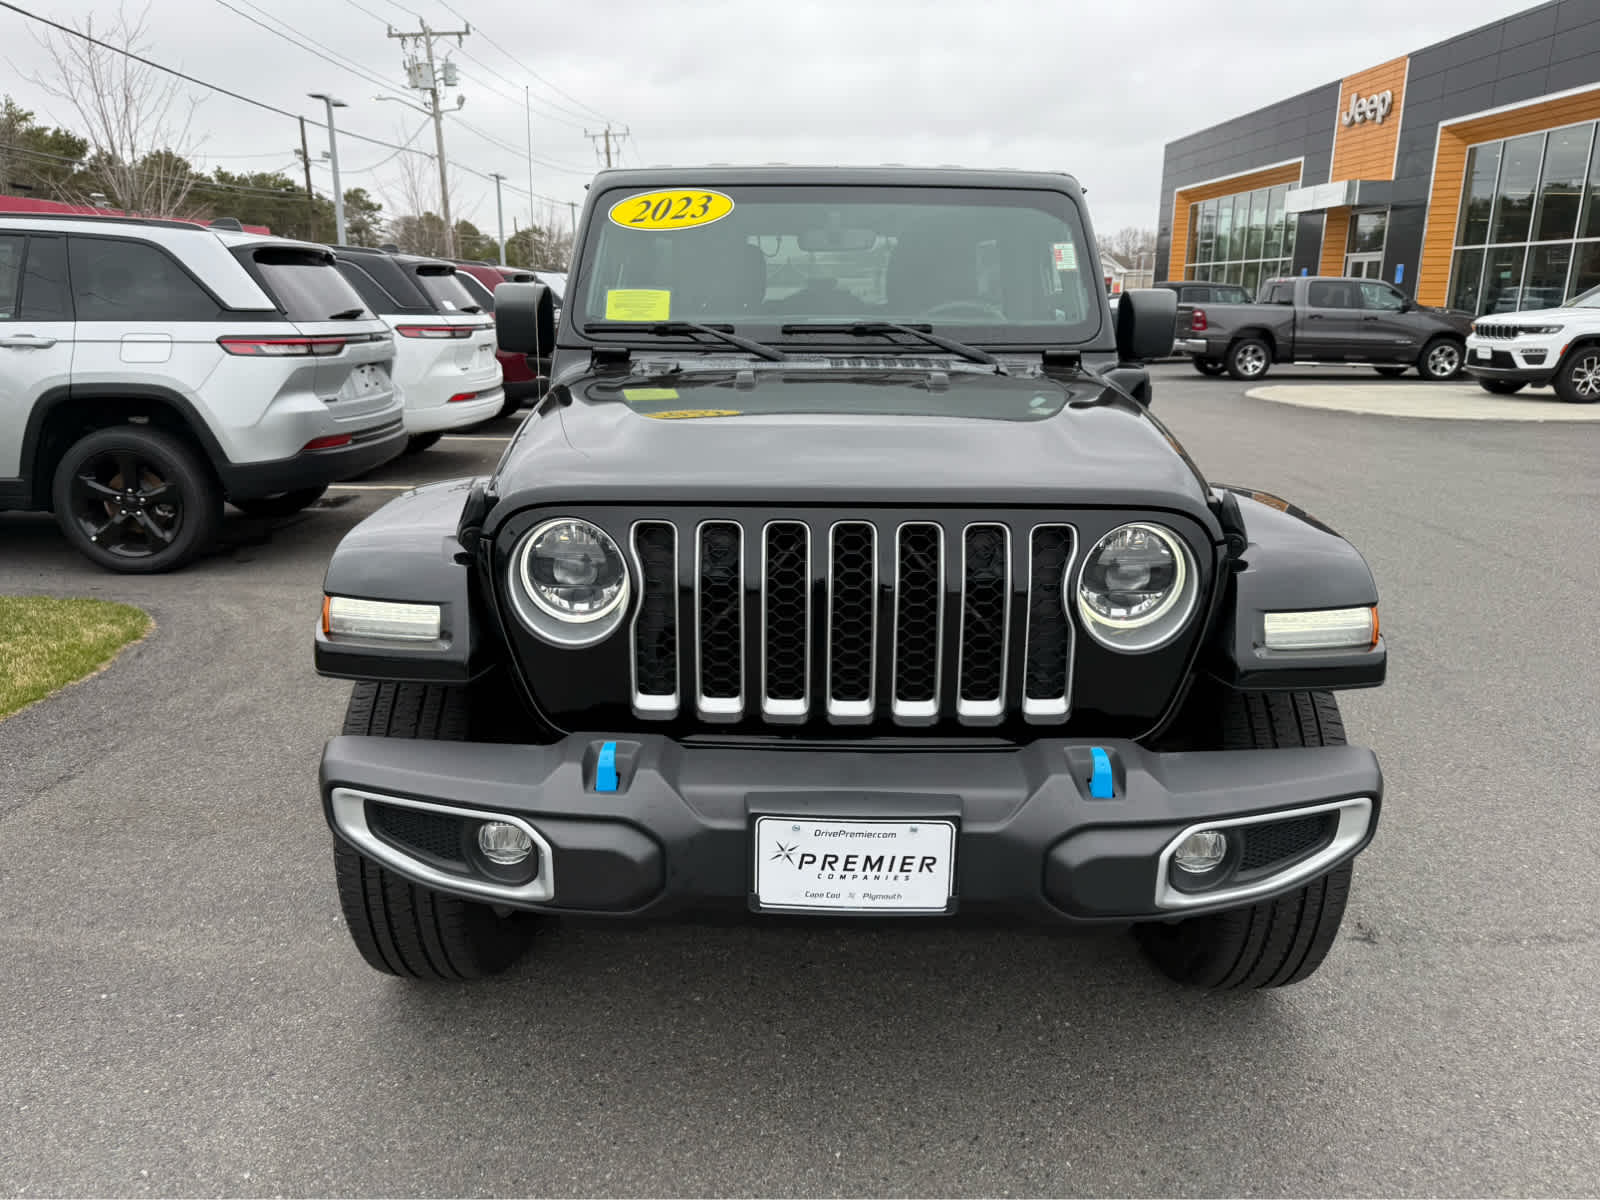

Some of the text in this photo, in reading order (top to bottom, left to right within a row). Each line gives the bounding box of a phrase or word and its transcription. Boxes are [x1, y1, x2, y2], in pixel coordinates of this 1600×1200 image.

[1342, 89, 1393, 126] Jeep
[629, 194, 713, 224] 2023
[814, 829, 897, 839] DrivePremier.com
[798, 853, 937, 873] PREMIER
[817, 873, 910, 881] COMPANIES
[805, 891, 903, 901] Cape Cod Plymouth
